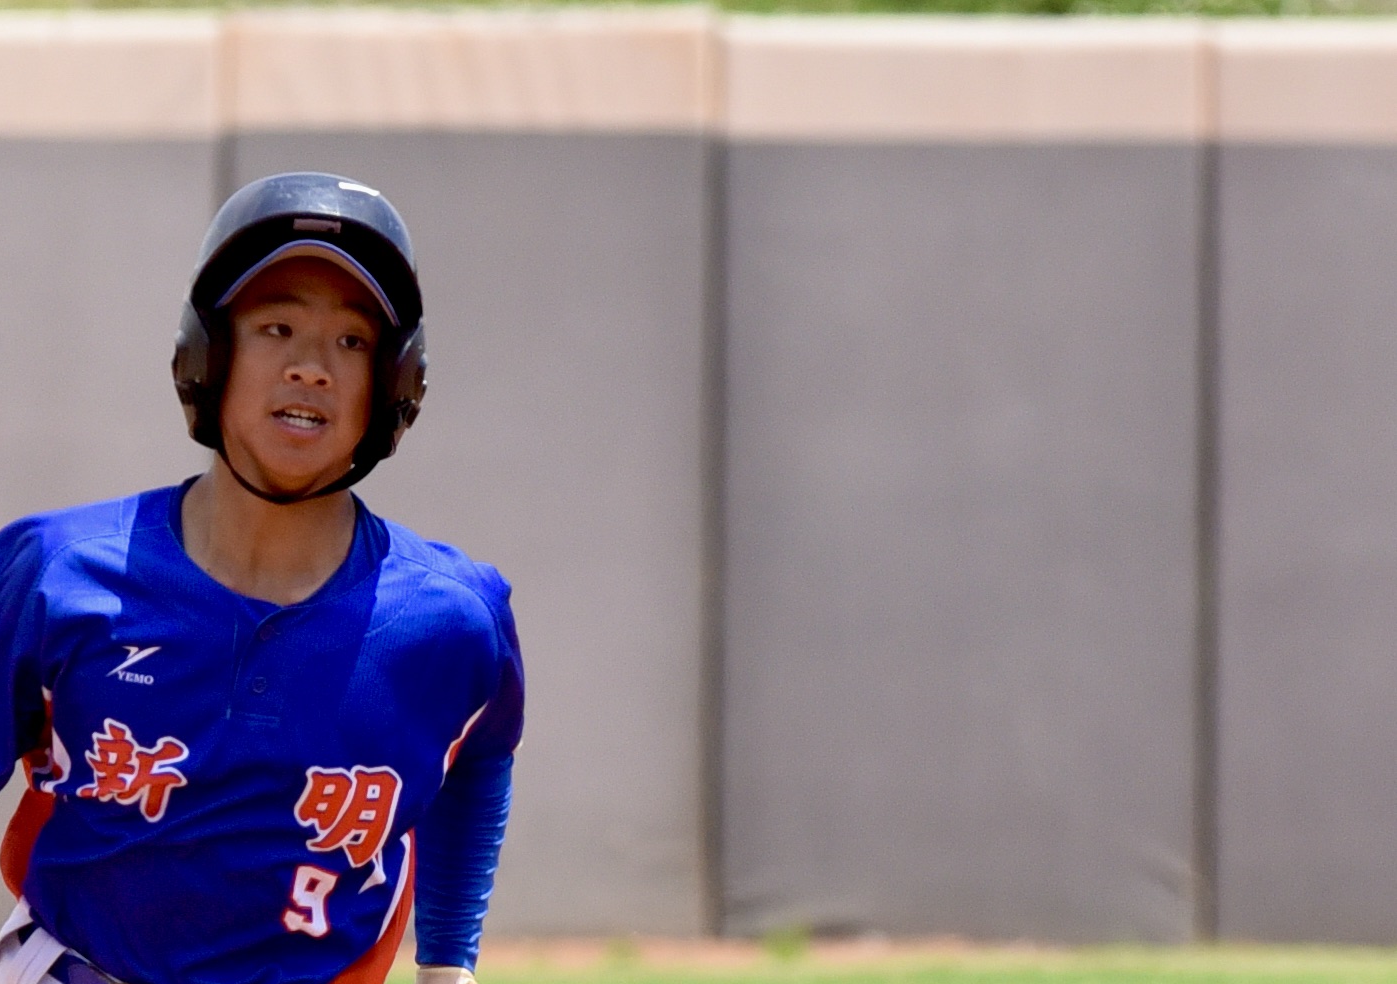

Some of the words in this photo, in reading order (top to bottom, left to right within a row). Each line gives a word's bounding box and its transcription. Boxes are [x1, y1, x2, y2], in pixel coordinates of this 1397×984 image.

[117, 670, 154, 685] YEMO
[77, 718, 189, 822] 新
[294, 765, 402, 868] 明
[282, 865, 338, 938] 9
